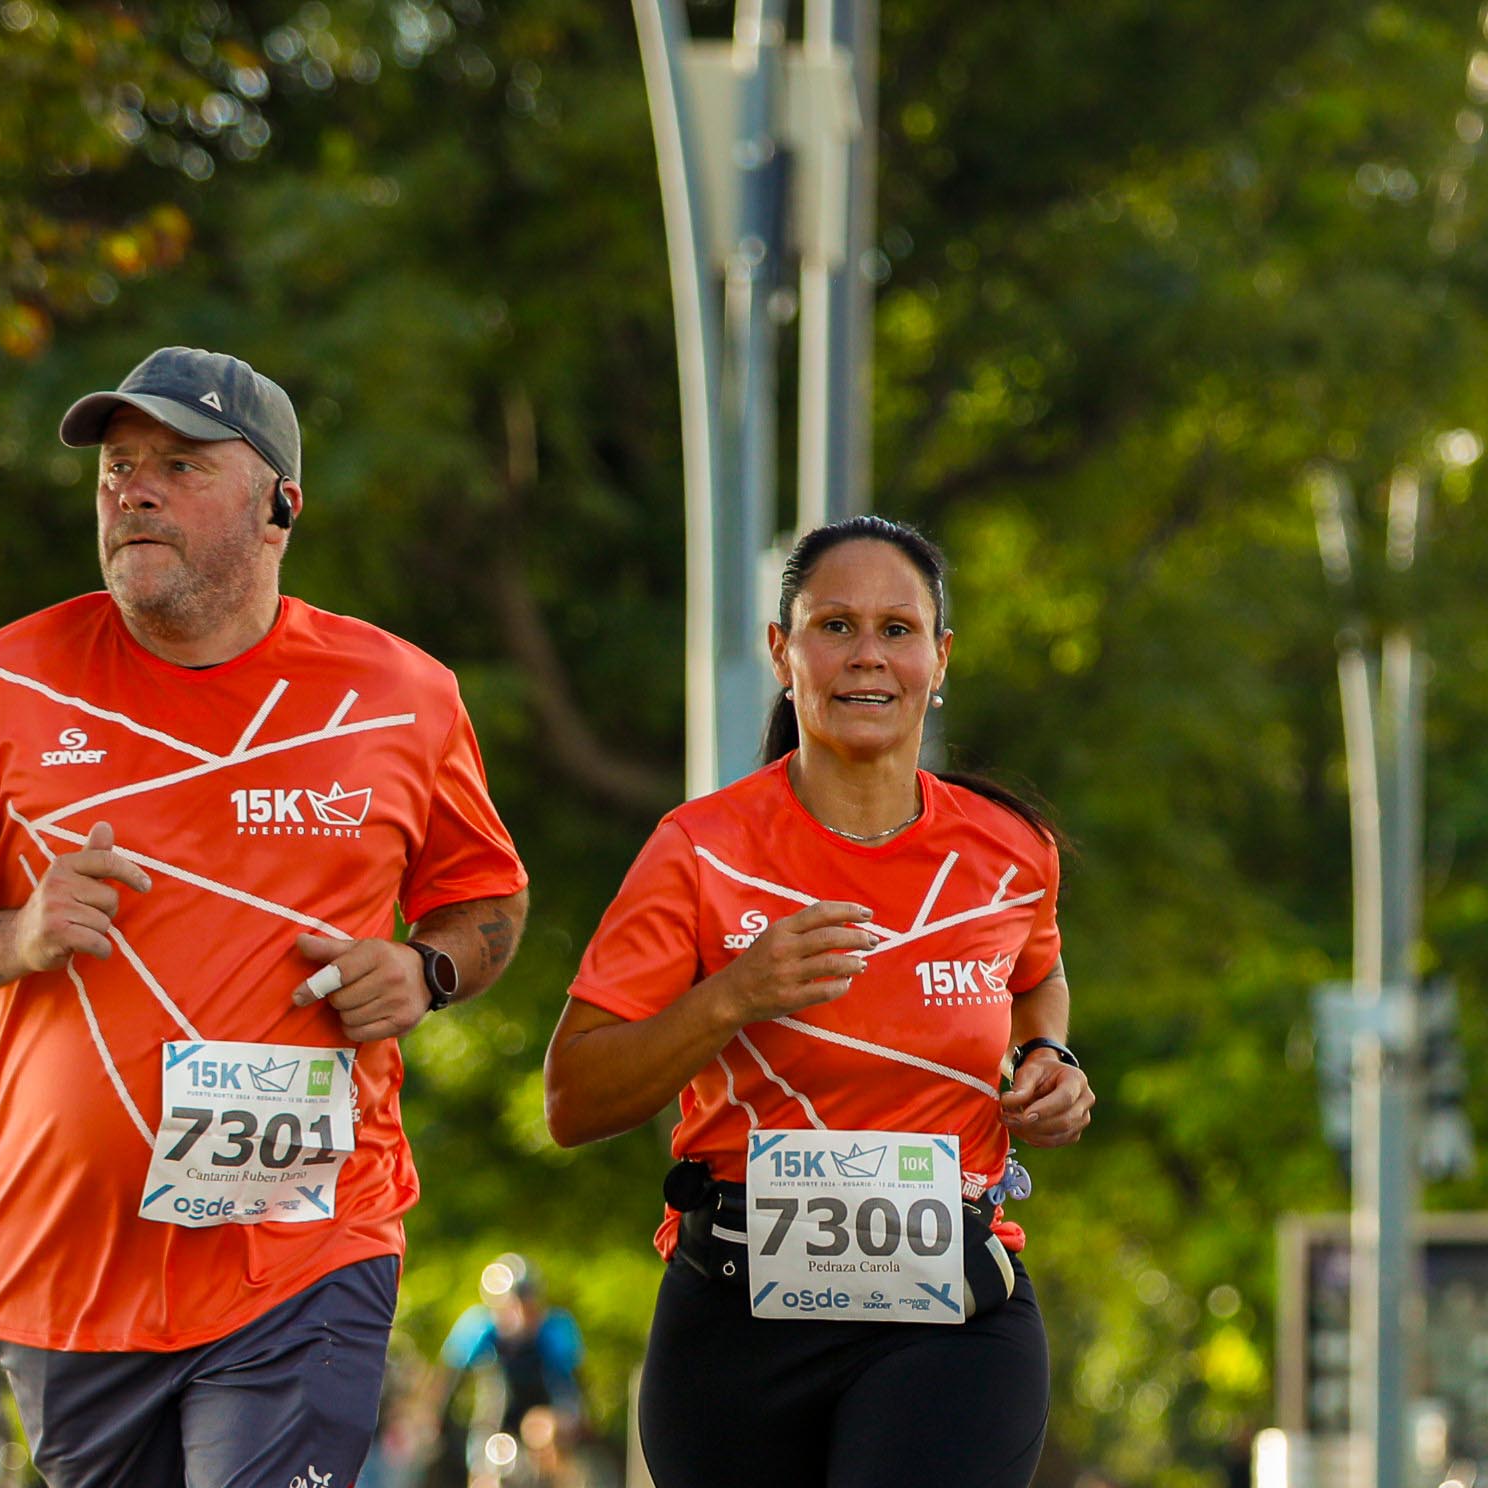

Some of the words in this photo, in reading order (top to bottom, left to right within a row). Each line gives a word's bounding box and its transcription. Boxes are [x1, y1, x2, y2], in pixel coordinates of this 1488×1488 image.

[230, 789, 304, 823] 15K
[237, 826, 304, 835] PUERTO
[312, 827, 361, 838] NORTE
[915, 961, 980, 995] 15K
[924, 996, 982, 1007] PUERTO
[187, 1060, 241, 1089] 15K
[312, 1071, 331, 1086] 10K
[164, 1106, 337, 1168] 7301
[186, 1167, 239, 1182] Cantarini
[242, 1170, 277, 1183] Ruben
[770, 1151, 826, 1178] 15K
[902, 1157, 929, 1171] 10K
[174, 1196, 235, 1218] osde
[755, 1197, 952, 1257] 7300
[808, 1261, 856, 1273] Pedraza
[860, 1261, 900, 1273] Carola
[782, 1287, 850, 1310] osde
